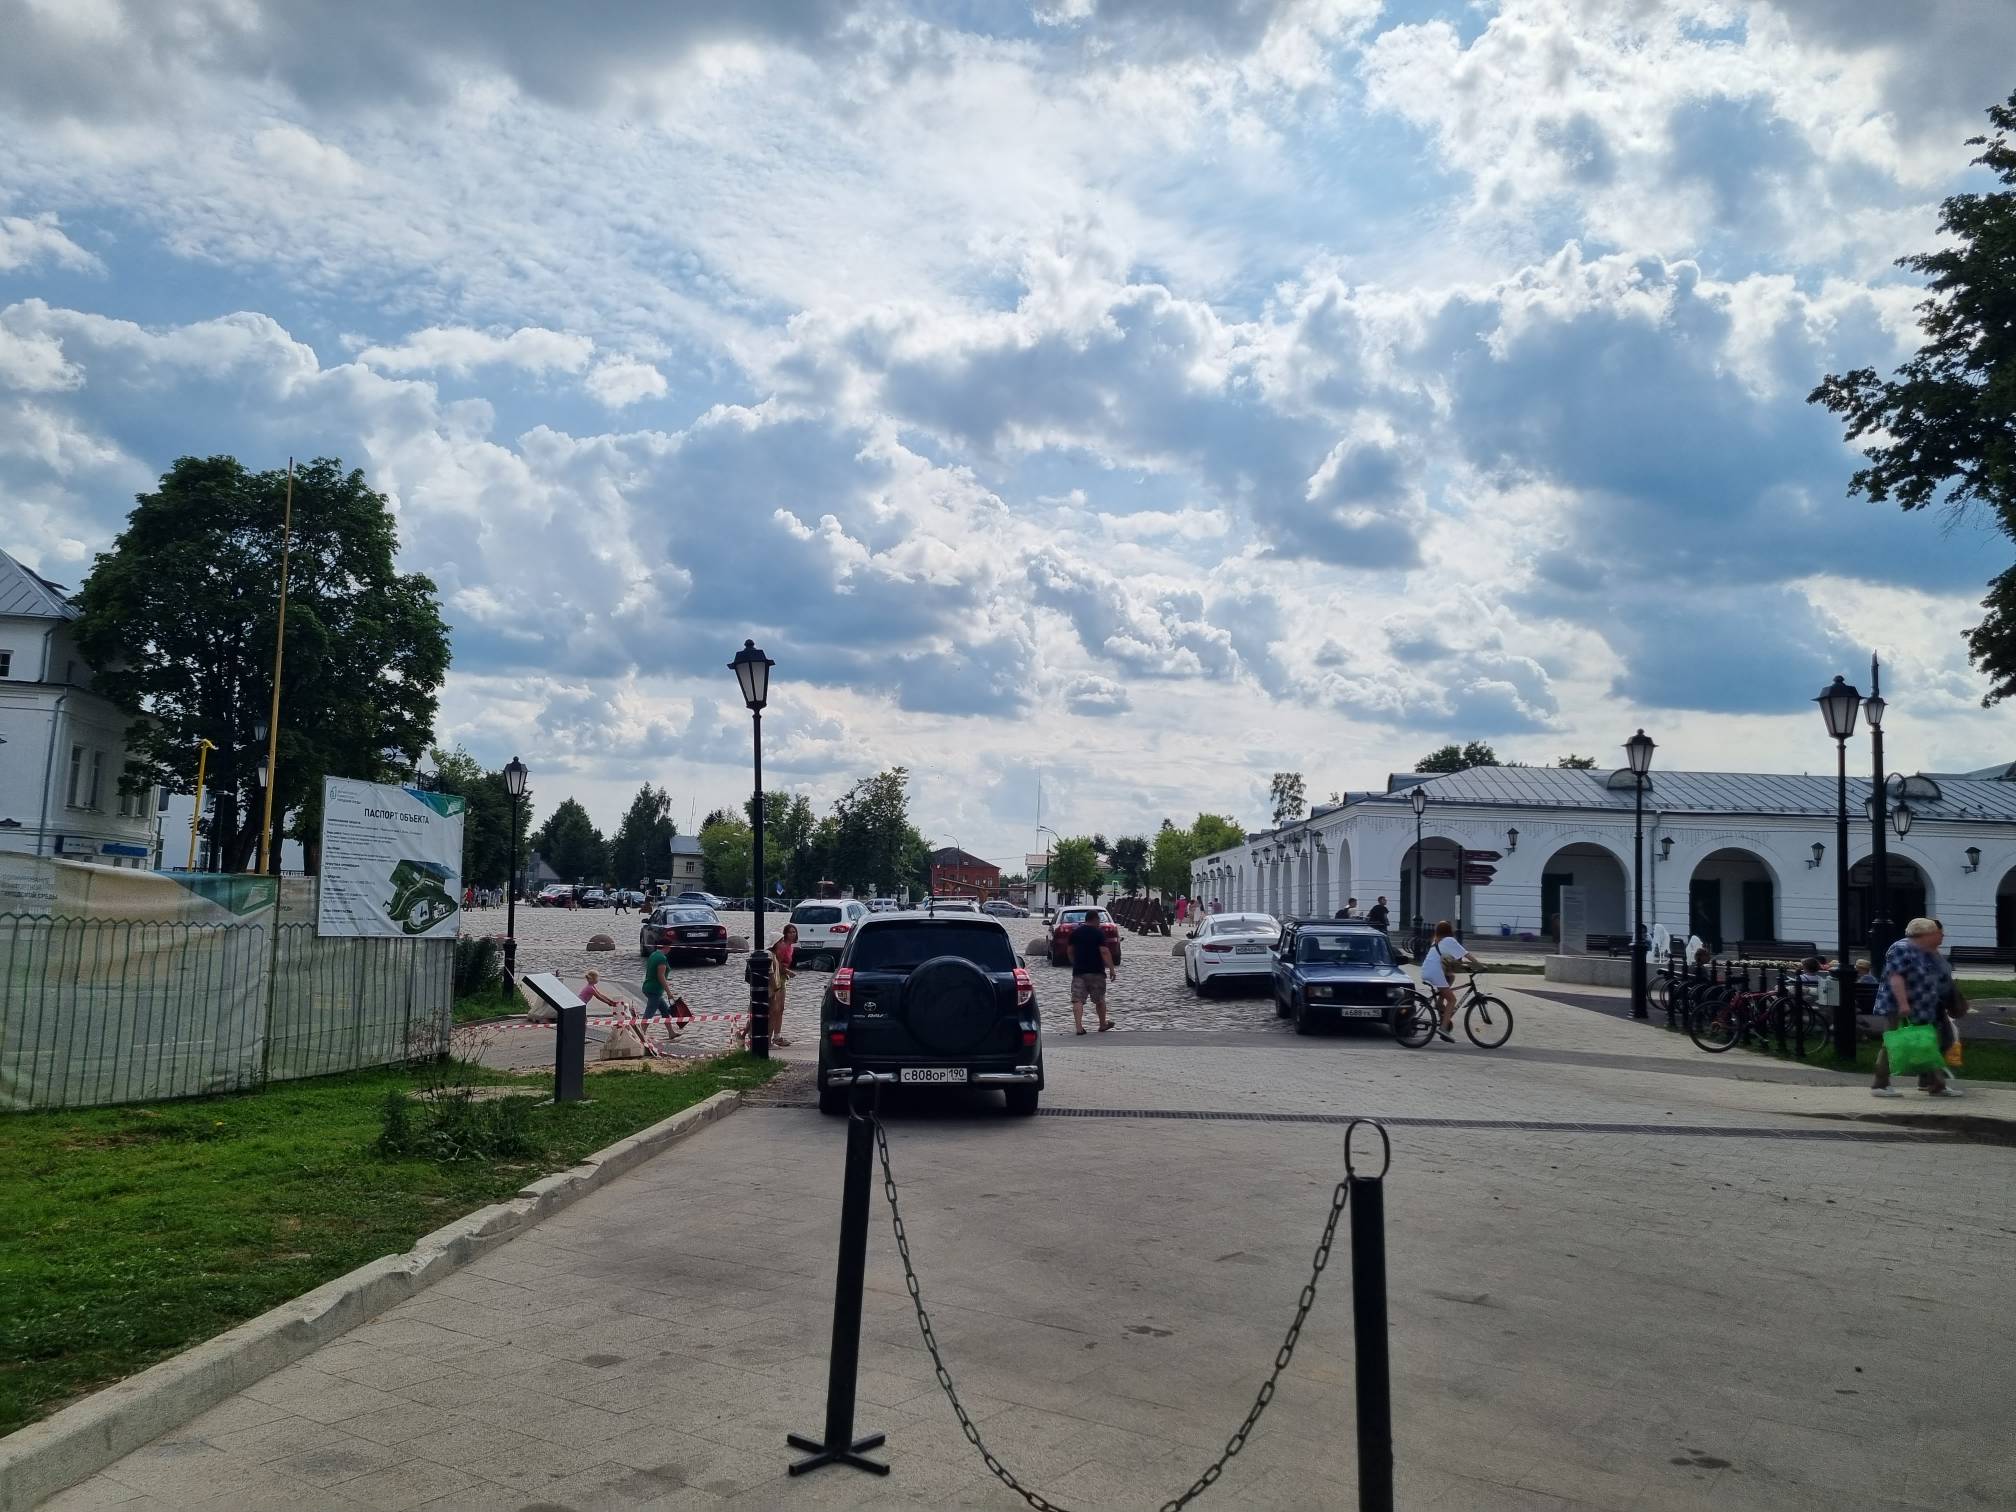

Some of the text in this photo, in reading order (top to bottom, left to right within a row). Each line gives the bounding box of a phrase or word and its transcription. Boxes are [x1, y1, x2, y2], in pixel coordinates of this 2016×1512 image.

[364, 808, 430, 824] ПАСПОРТ ОБЪЕКТА
[904, 1070, 946, 1081] С808ОР
[948, 1069, 965, 1077] 190
